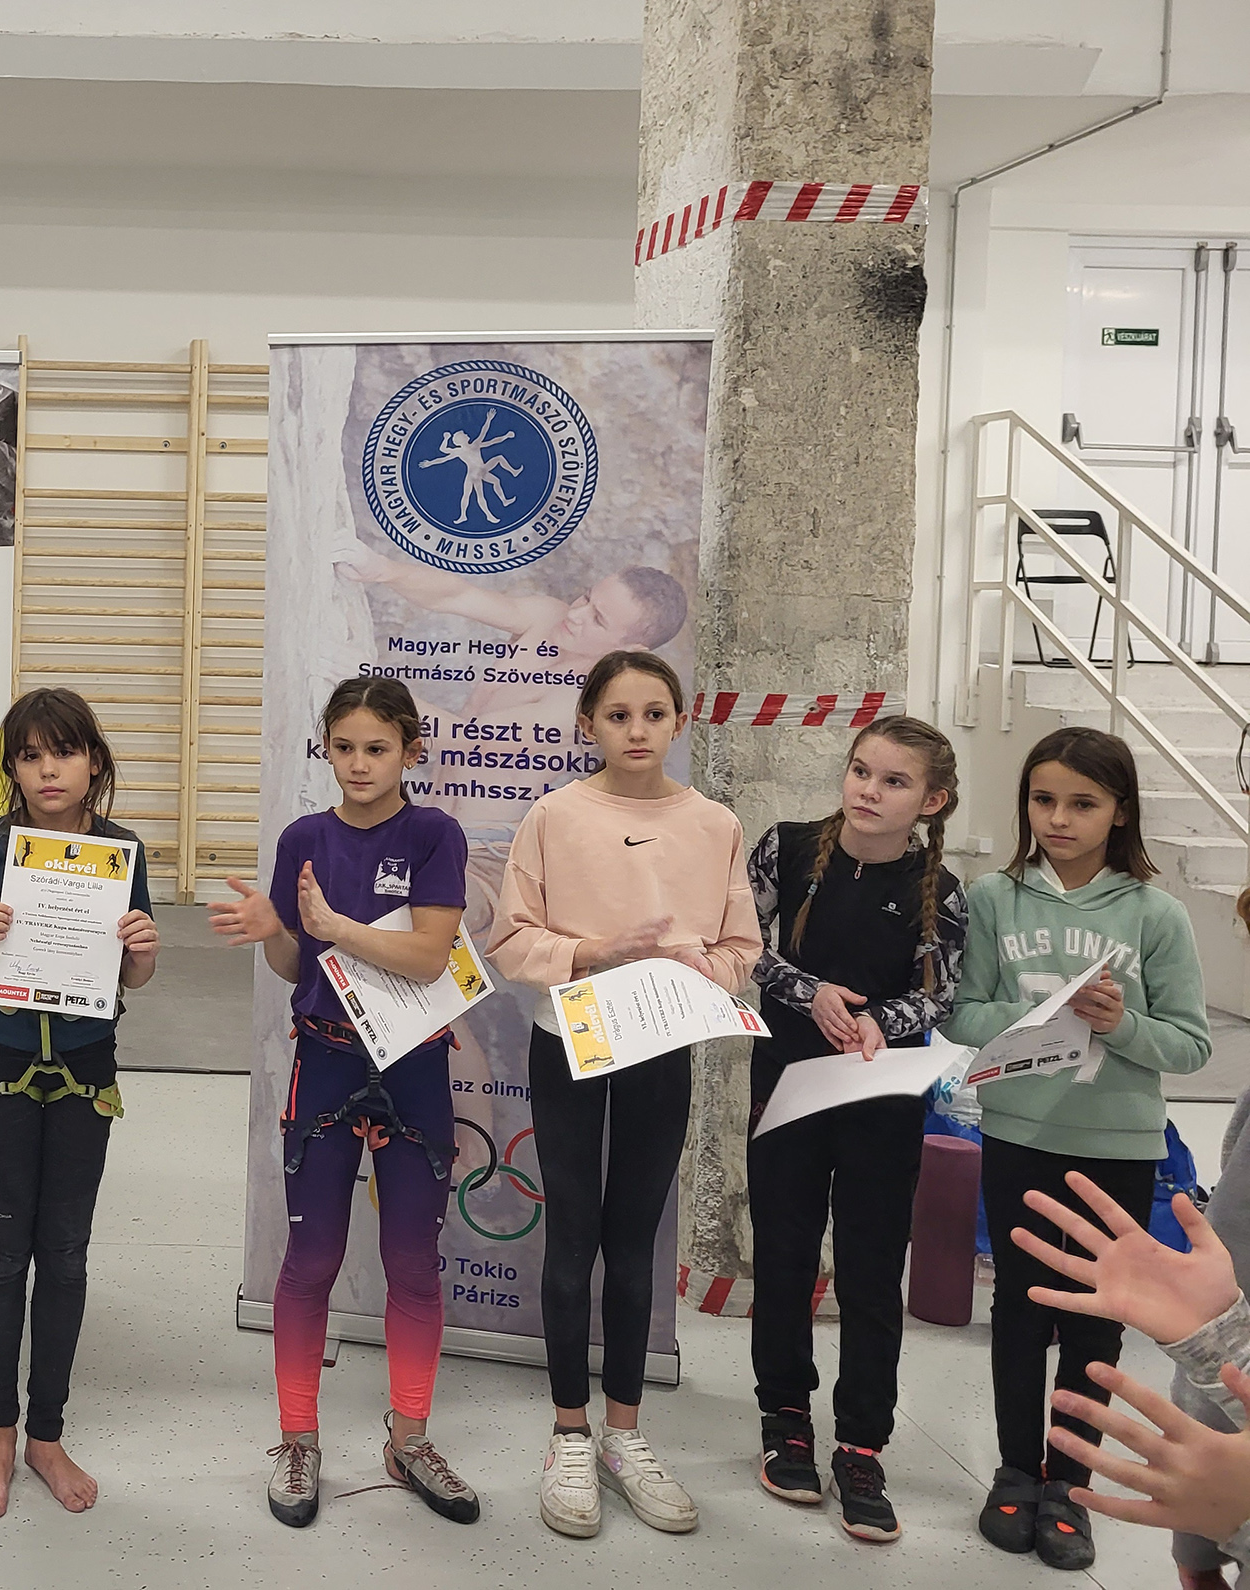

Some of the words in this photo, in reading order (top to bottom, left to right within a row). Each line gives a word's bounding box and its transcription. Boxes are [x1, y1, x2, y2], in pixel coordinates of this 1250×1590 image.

[416, 389, 443, 412] ÉS
[446, 377, 570, 434] SPORTMÁSZÓ
[381, 410, 418, 459] HEGY-
[380, 464, 422, 535] MAGYAR
[531, 436, 584, 537] SZÖVETSÉG
[435, 537, 517, 560] MHSSZ
[388, 637, 461, 656] Magyar
[468, 639, 528, 658] Hegy-
[536, 640, 559, 657] és
[359, 663, 475, 682] Sportmászó
[483, 667, 587, 689] Szövetség
[451, 718, 521, 743] részt
[533, 722, 561, 744] te
[441, 745, 600, 774] mászásokb
[44, 859, 97, 875] oklevél
[328, 959, 347, 988] MOUNTEX
[65, 994, 90, 1006] PETZL
[361, 1019, 378, 1045] PETZL
[584, 1003, 605, 1043] oklevél
[452, 1080, 474, 1093] az
[455, 1257, 517, 1280] Tokio
[453, 1284, 520, 1308] Párizs
